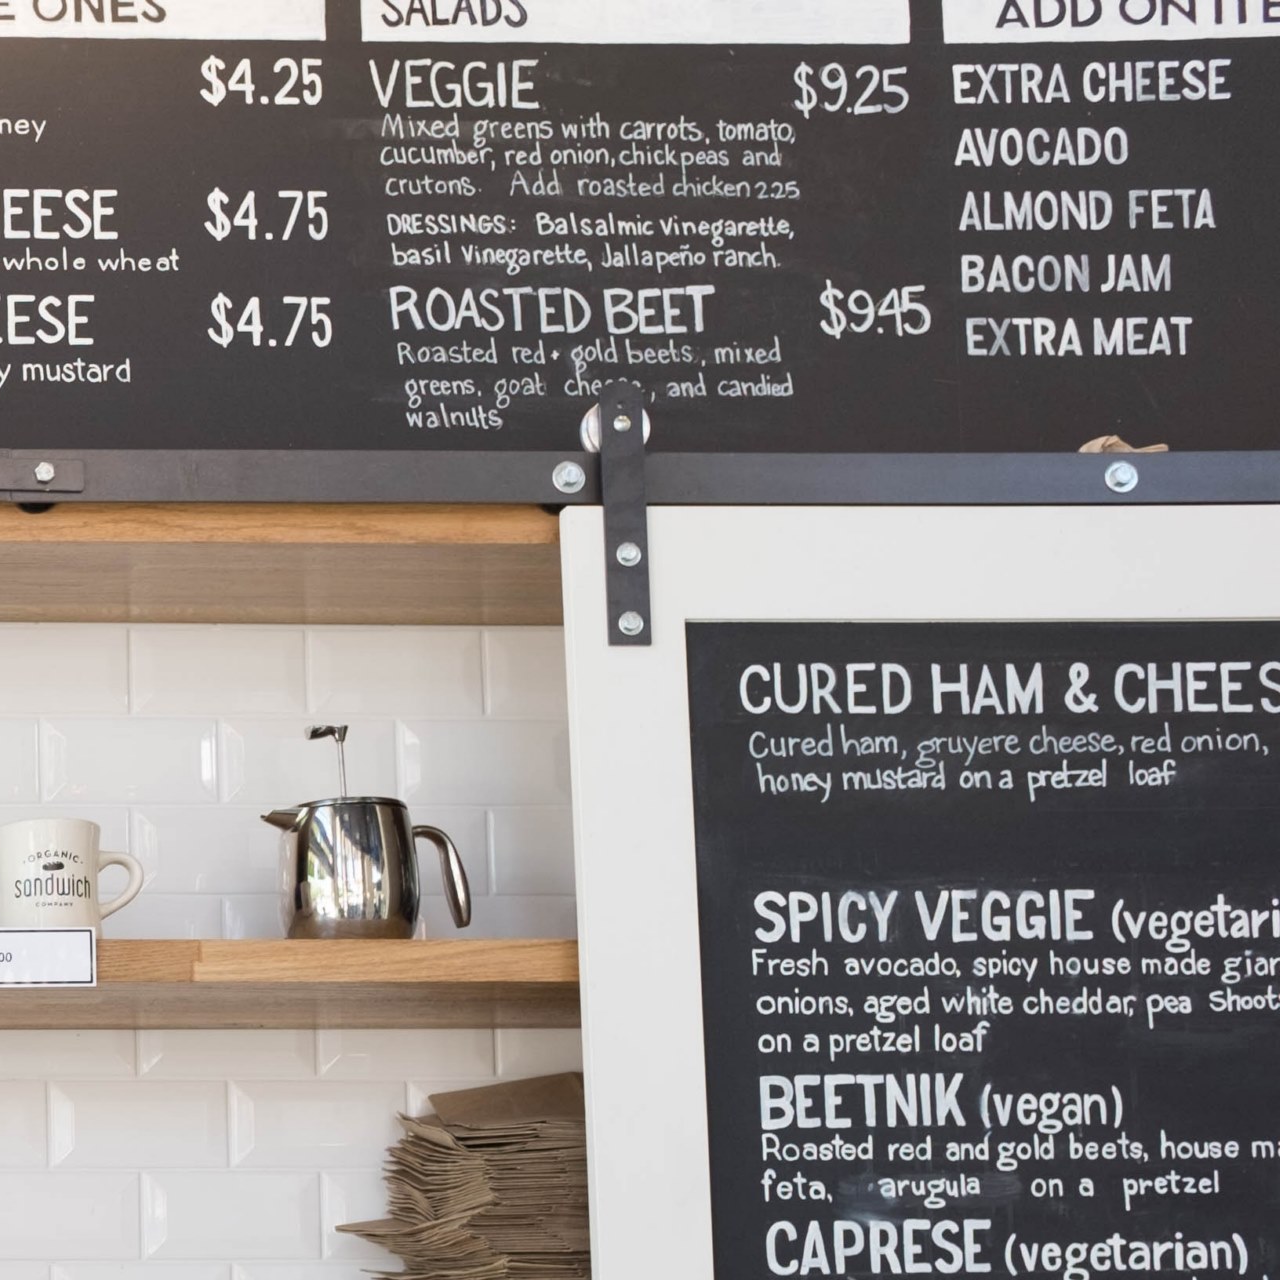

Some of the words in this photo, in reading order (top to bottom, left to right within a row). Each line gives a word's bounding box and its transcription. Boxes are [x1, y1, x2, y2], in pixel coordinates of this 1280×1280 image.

[200, 55, 322, 106] $4.25
[369, 59, 539, 109] VEGGIE
[794, 62, 909, 119] $9.25
[952, 63, 1070, 104] EXTRA
[1083, 59, 1231, 102] CHEESE
[382, 113, 459, 139] Mixed
[473, 120, 553, 148] greens
[562, 112, 609, 138] with
[620, 116, 709, 144] carrots,
[717, 119, 795, 144] tomato,
[955, 127, 1128, 166] AVOCADO
[204, 187, 328, 241] $4.75
[387, 214, 515, 236] DRESSINGS:
[536, 212, 653, 236] Balsalmic
[959, 191, 1112, 231] ALMOND
[1129, 189, 1216, 229] FETA
[961, 255, 1089, 292] BACON
[1101, 254, 1170, 292] JAM
[208, 292, 332, 348] $4.75
[389, 286, 591, 333] ROASTED
[603, 285, 715, 334] BEET
[820, 279, 931, 339] $9.45
[966, 317, 1082, 356] EXTRA
[1094, 317, 1192, 355] MEAT
[740, 663, 911, 714] CURED
[931, 663, 1043, 714] HAM
[1065, 662, 1098, 713] &
[28, 849, 80, 864] ORGANIC
[15, 873, 91, 899] sandwich
[754, 891, 898, 943] SPICY
[915, 889, 1094, 942] VEGGIE
[760, 1073, 966, 1130] BEETNIK
[981, 1083, 1122, 1133] (vegan)
[766, 1219, 991, 1275] CAPRESE
